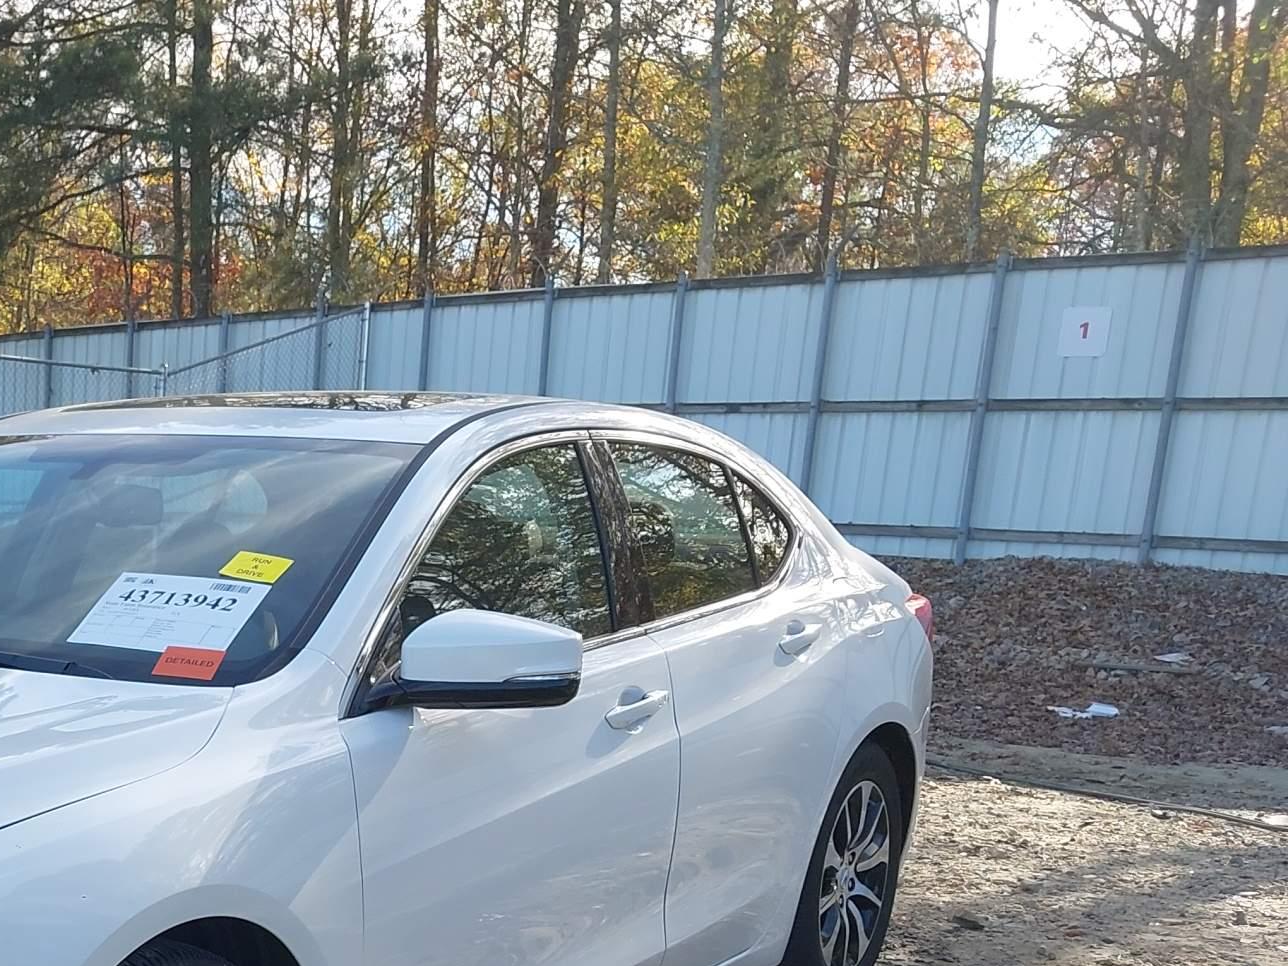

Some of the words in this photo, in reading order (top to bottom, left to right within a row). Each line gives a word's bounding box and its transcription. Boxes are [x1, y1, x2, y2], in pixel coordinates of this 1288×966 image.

[1080, 322, 1089, 339] 1
[252, 557, 272, 565] RUN
[236, 568, 264, 577] DRIVE
[119, 589, 238, 612] 43713942
[165, 656, 214, 667] DETAILED
